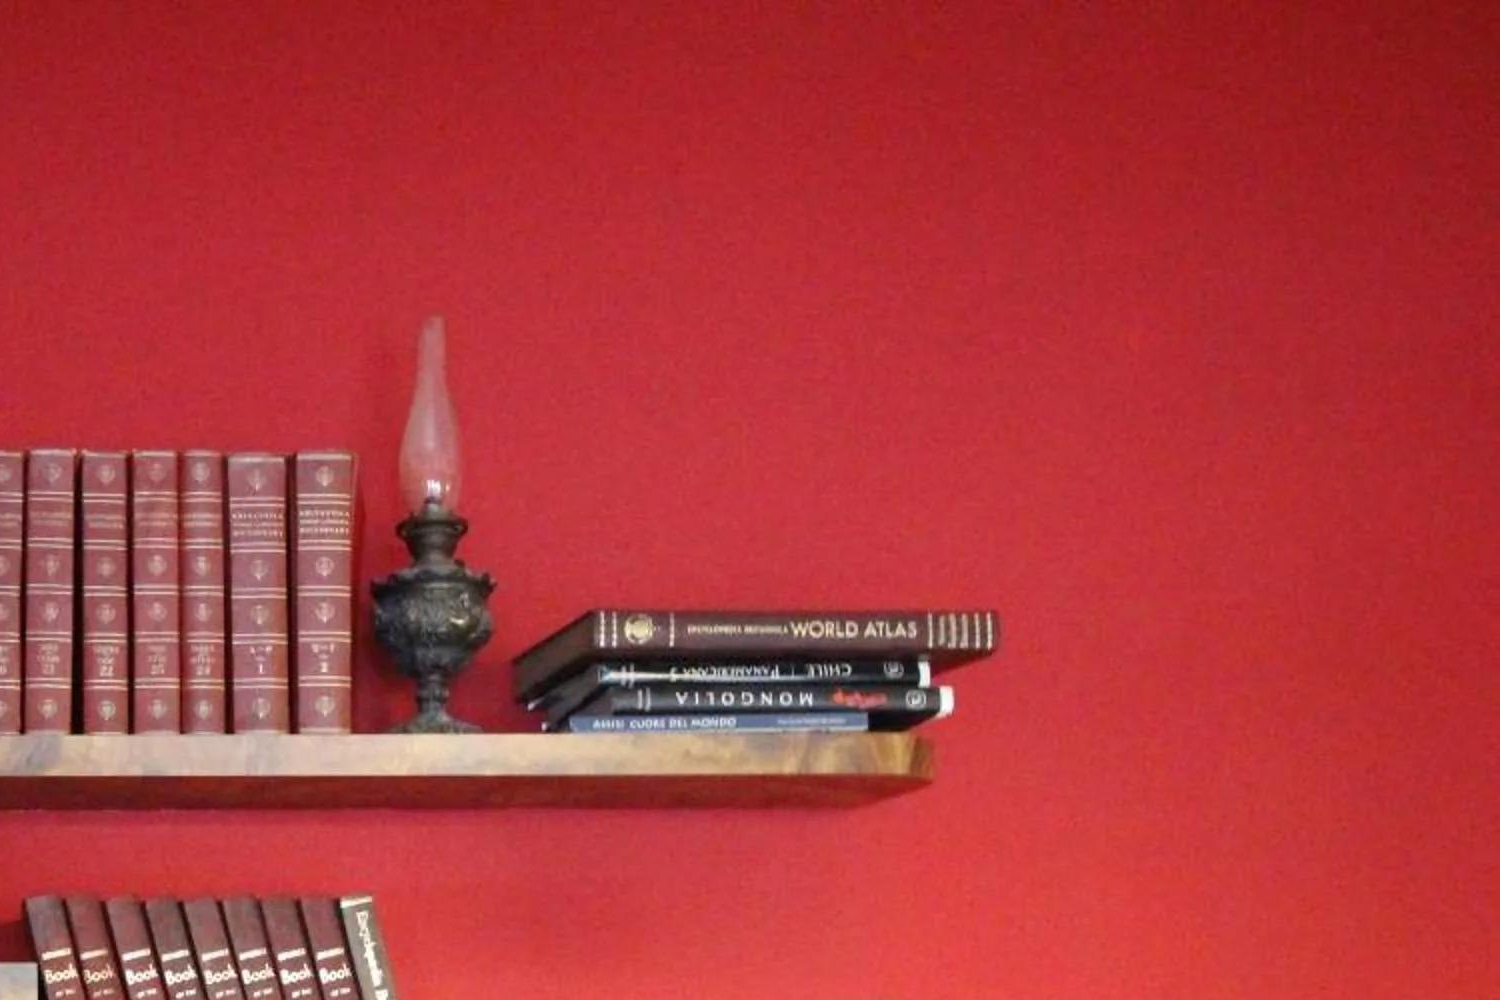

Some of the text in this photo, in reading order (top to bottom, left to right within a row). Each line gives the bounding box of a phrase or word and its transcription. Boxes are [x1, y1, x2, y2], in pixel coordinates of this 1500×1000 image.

[789, 620, 860, 639] WORLD
[863, 620, 918, 639] ATLAS
[674, 690, 814, 708] MONGOLIA
[44, 963, 79, 984] Book
[125, 963, 159, 986] Book
[165, 963, 198, 985] Book
[204, 963, 238, 985] Book
[241, 963, 275, 985] Book
[279, 963, 313, 985] Book
[319, 963, 352, 985] Book
